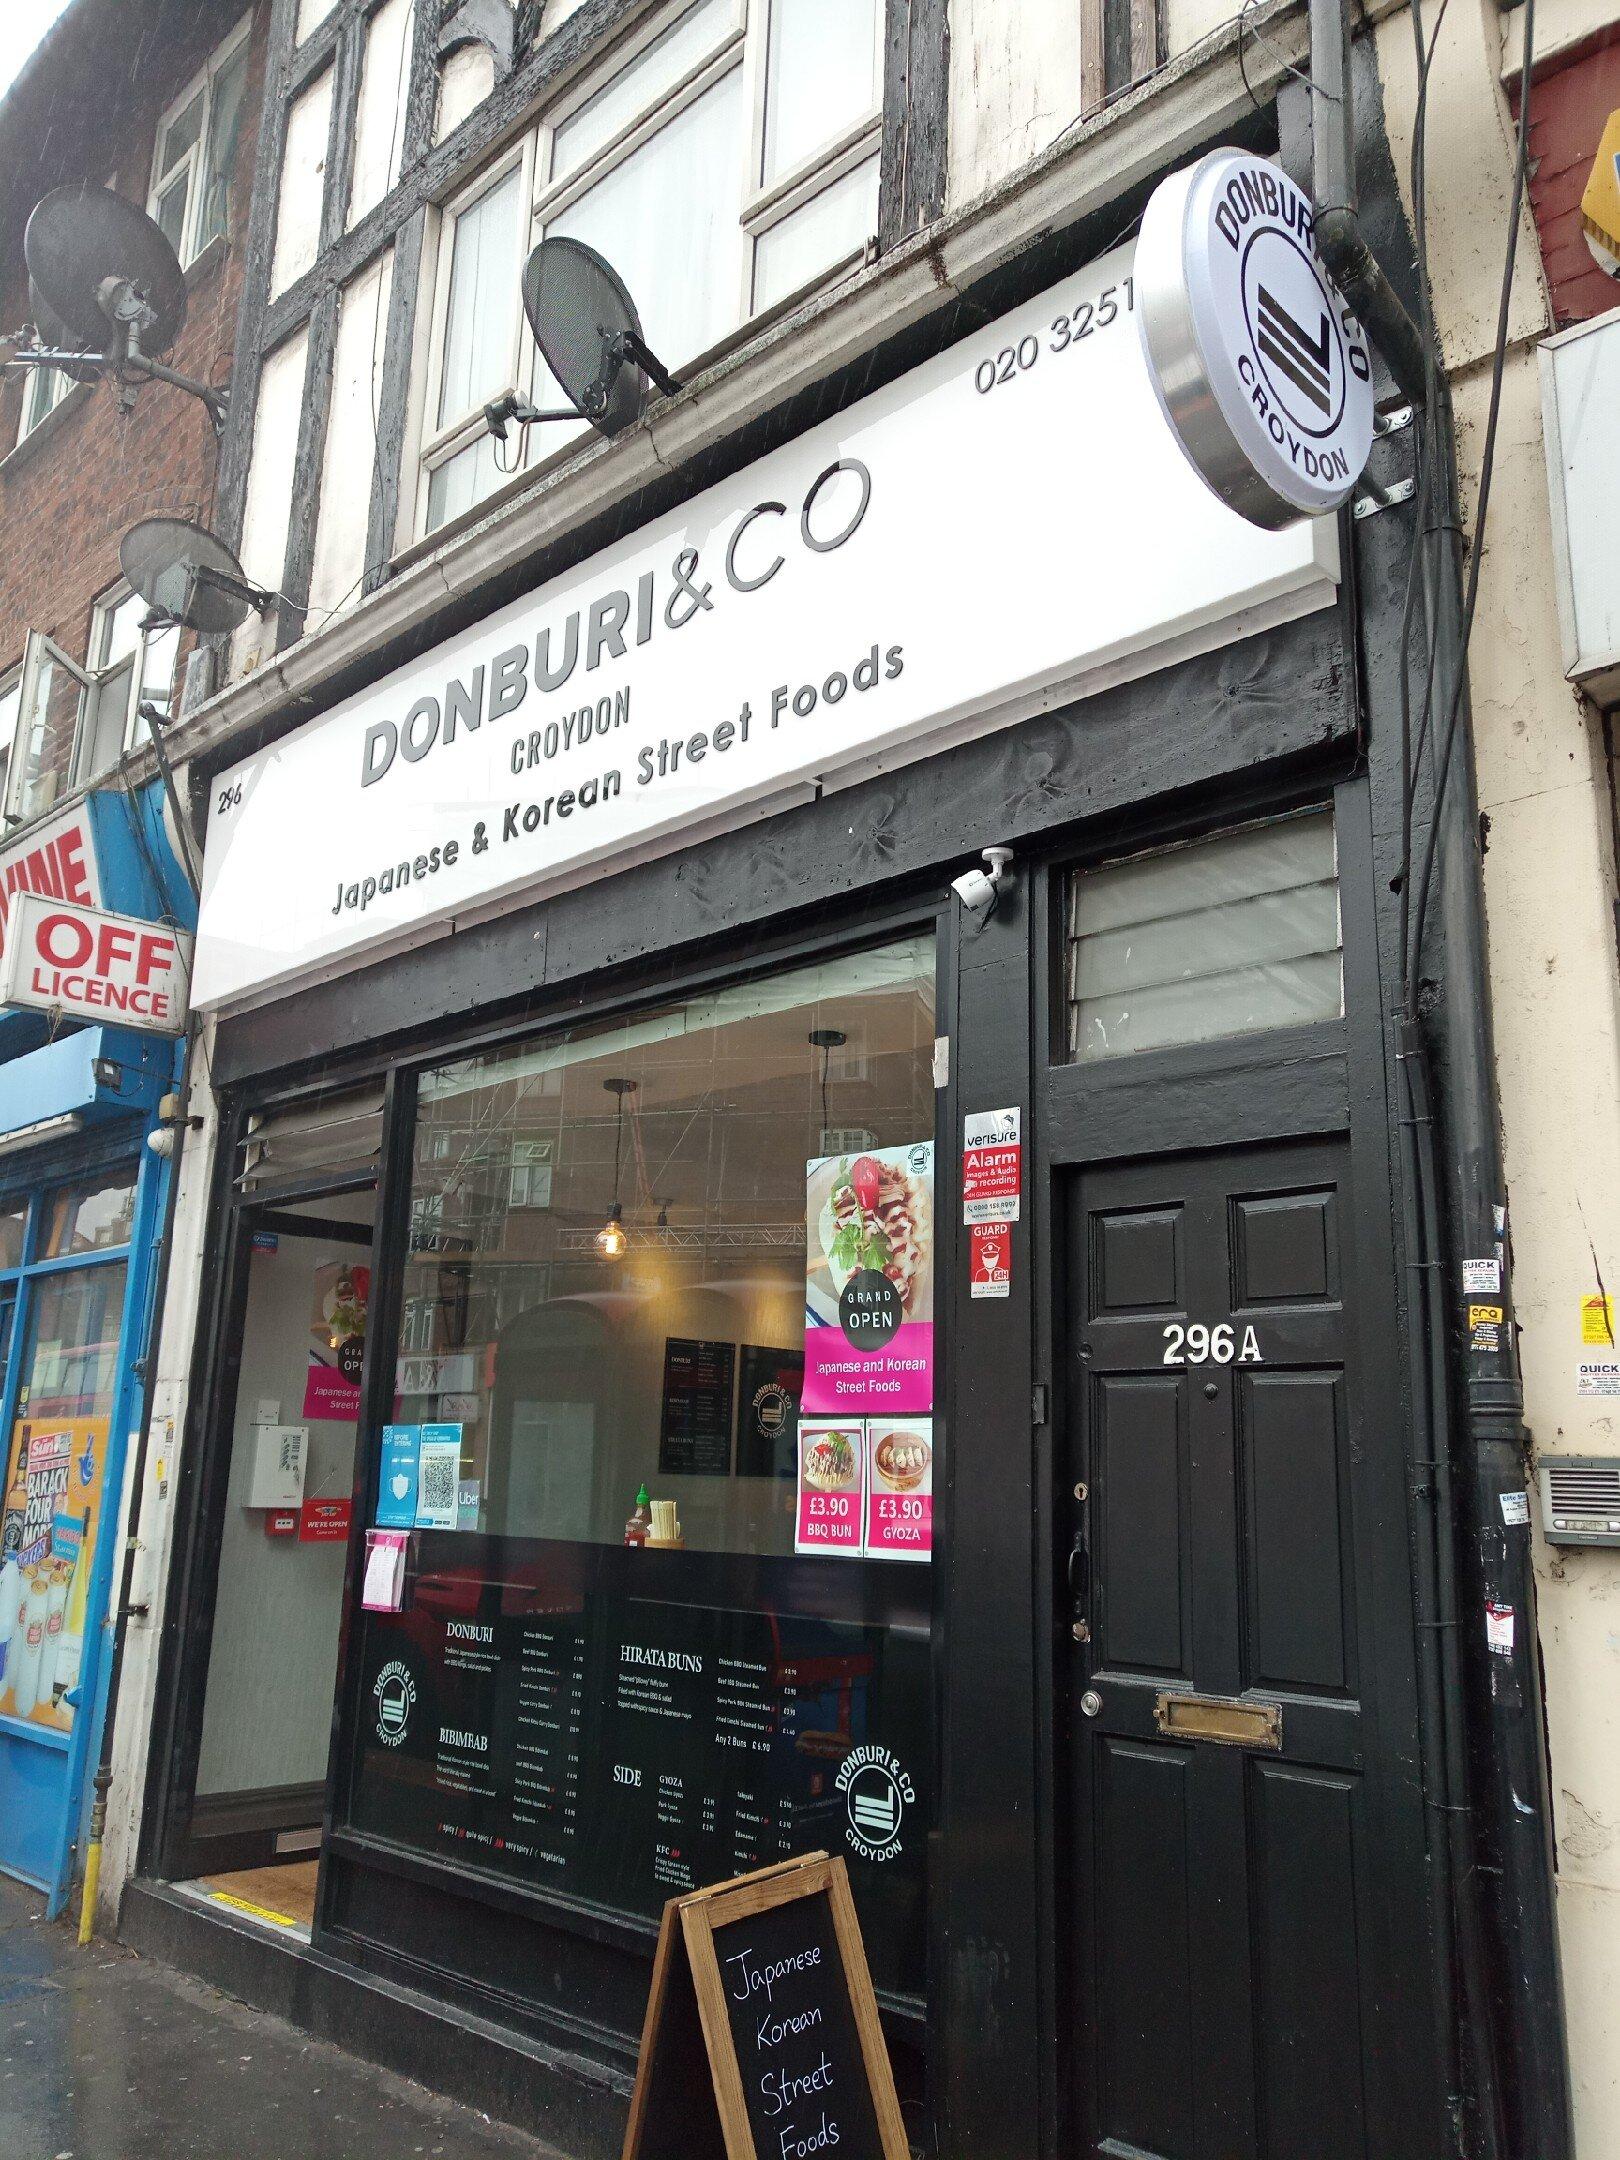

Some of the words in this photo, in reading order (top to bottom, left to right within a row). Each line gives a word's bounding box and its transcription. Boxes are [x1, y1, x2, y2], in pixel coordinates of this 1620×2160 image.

[1215, 170, 1320, 261] DONBUR
[974, 334, 1039, 395] 020
[1050, 277, 1134, 353] 3251
[1237, 355, 1349, 483] CROYDON
[510, 685, 630, 774] CROYDON
[331, 839, 459, 915] Japanese
[471, 821, 489, 855] &
[502, 769, 621, 842] Korean
[637, 701, 752, 785] Street
[771, 643, 904, 729] Foods
[218, 783, 242, 814] 296
[35, 914, 175, 986] OFF
[31, 967, 170, 1018] LICENCE
[967, 1131, 1017, 1147] verisure
[966, 1151, 1017, 1169] Alarm
[979, 1176, 1017, 1187] recording
[974, 1224, 1008, 1237] GUARD
[848, 1291, 892, 1304] GRAND
[850, 1312, 893, 1328] OPEN
[1471, 1307, 1498, 1319] era
[344, 1348, 362, 1357] GRA
[344, 1360, 364, 1372] OPE
[816, 1360, 861, 1376] Japanese
[863, 1358, 884, 1372] and
[886, 1357, 926, 1372] Korean
[1580, 1365, 1620, 1373] QUICK
[314, 1386, 352, 1398] Japanese
[835, 1380, 866, 1394] Street
[869, 1379, 901, 1393] Foods
[329, 1400, 355, 1410] Street
[27, 1467, 69, 1498] BARACK
[459, 1491, 479, 1505] Uber
[809, 1497, 849, 1517] £3.90
[24, 1497, 53, 1525] FOUR
[878, 1499, 923, 1520] £3.90
[328, 1520, 348, 1528] OPEN
[807, 1522, 829, 1538] BBQ
[831, 1524, 852, 1538] BUN
[883, 1526, 921, 1541] GYOZA
[23, 1522, 53, 1549] MOR
[446, 1622, 494, 1643] DONBURI
[620, 1645, 667, 1668] HIRATA
[667, 1651, 703, 1673] BUNS
[373, 1661, 406, 1697] DONBURI
[376, 1723, 407, 1747] CROYDON
[439, 1727, 488, 1752] BIBIMBAB
[715, 1733, 727, 1746] Any
[727, 1735, 732, 1745] 2
[732, 1736, 747, 1748] Buns
[613, 1765, 642, 1788] SIDE
[659, 1775, 683, 1788] GYOZA
[834, 1745, 891, 1792] DONBURI
[890, 1759, 900, 1777] &
[899, 1772, 915, 1804] CO
[656, 1844, 670, 1855] KFC
[845, 1828, 903, 1862] CROYDON
[725, 1947, 821, 2002] Japanese
[756, 2007, 822, 2050] Korean
[761, 2051, 834, 2116] Street
[780, 2112, 840, 2160] Foods
